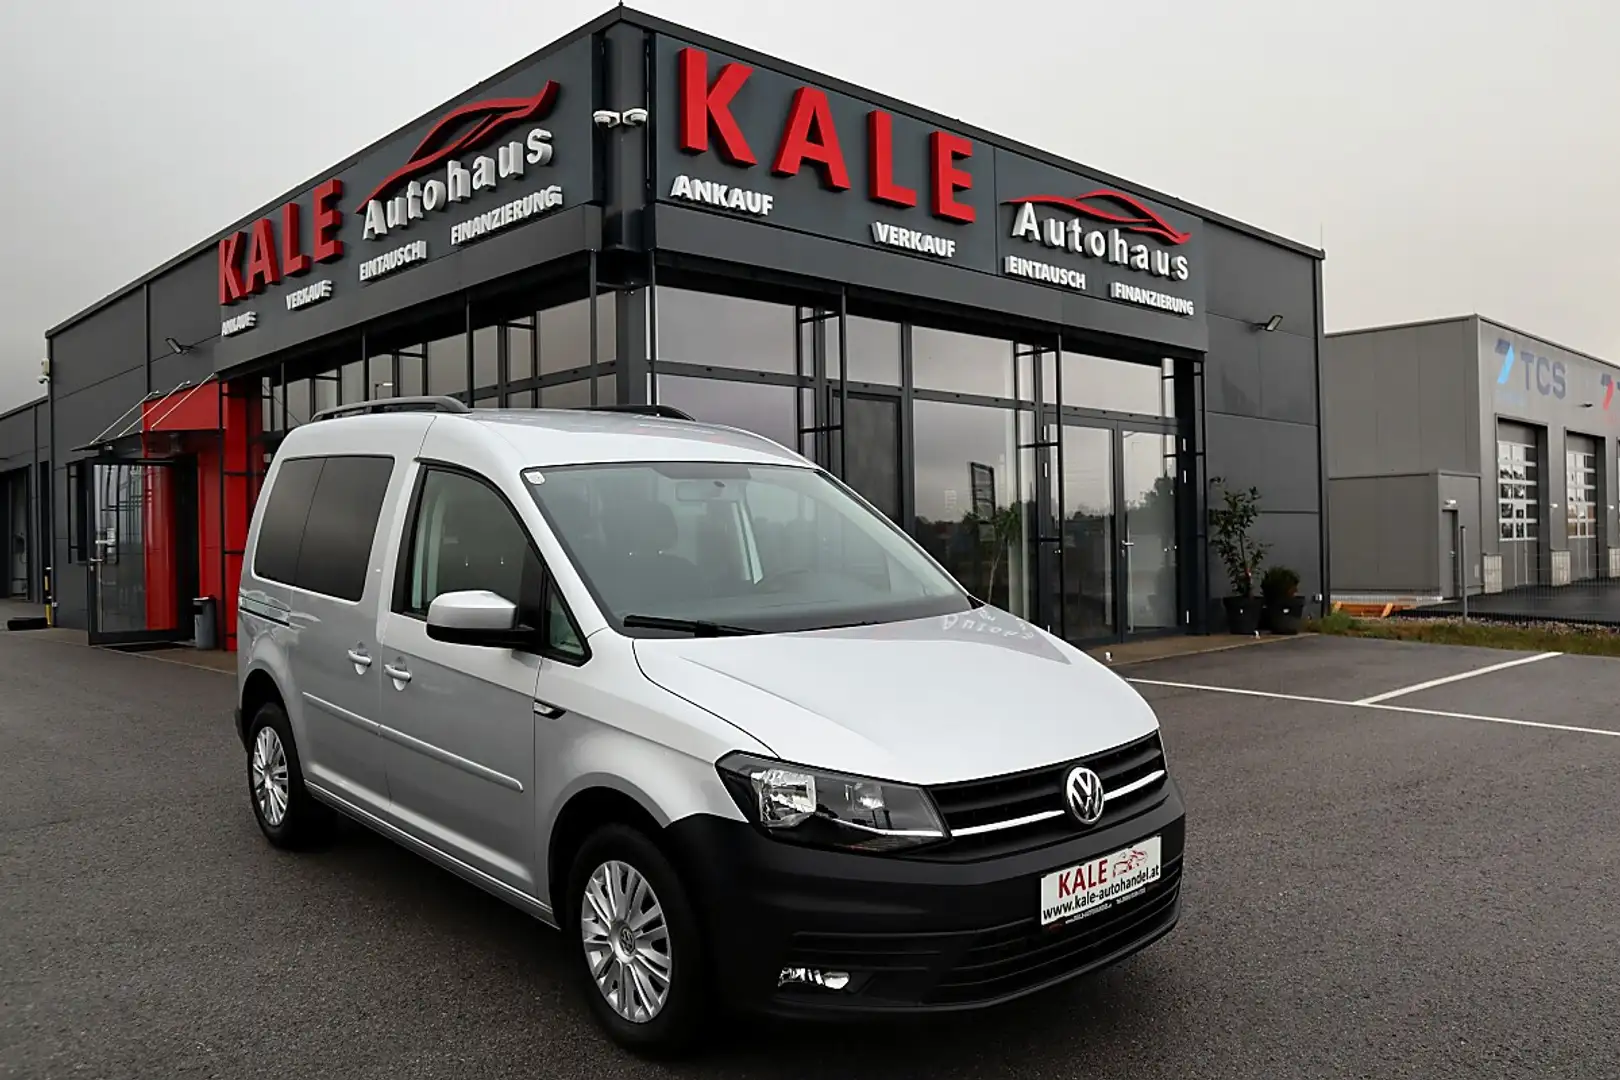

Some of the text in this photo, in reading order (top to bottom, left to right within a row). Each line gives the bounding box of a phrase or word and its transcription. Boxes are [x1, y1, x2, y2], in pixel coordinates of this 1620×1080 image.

[362, 128, 553, 240] Autohaus
[679, 47, 976, 224] KALE
[218, 178, 344, 306] KALE
[359, 240, 427, 282] EINTAUSCH
[450, 184, 563, 246] FINANZIERUNG
[670, 175, 1194, 316] ANKAUF VERKAUF EINTAUSCH FINANZIERUNG
[1012, 201, 1189, 281] Autohaus
[1042, 864, 1160, 920] www.kale-autohandel.at
[1058, 859, 1108, 899] KALE
